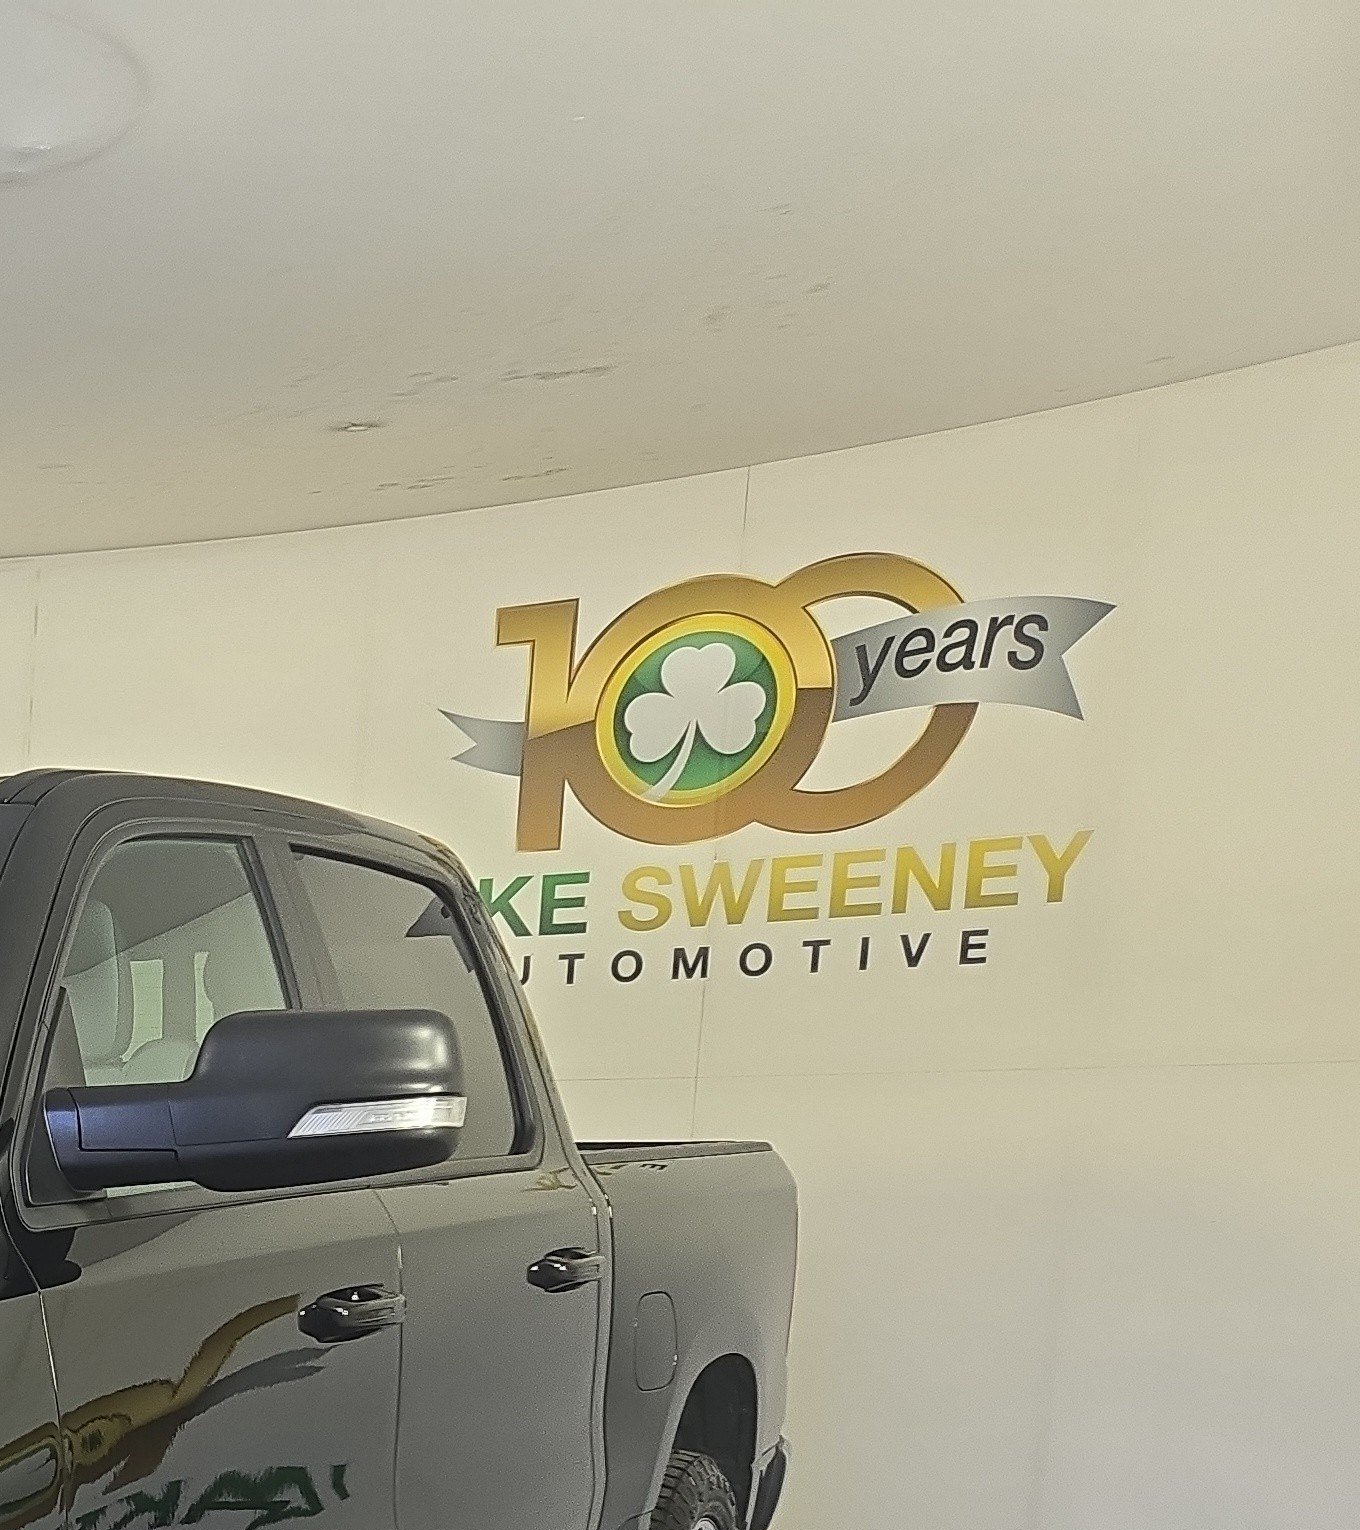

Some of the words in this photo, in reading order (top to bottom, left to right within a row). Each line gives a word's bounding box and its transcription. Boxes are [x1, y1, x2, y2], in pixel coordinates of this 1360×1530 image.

[496, 552, 980, 852] 100
[850, 611, 1048, 706] years
[478, 870, 591, 937] KE
[617, 830, 1094, 933] SWEENEY
